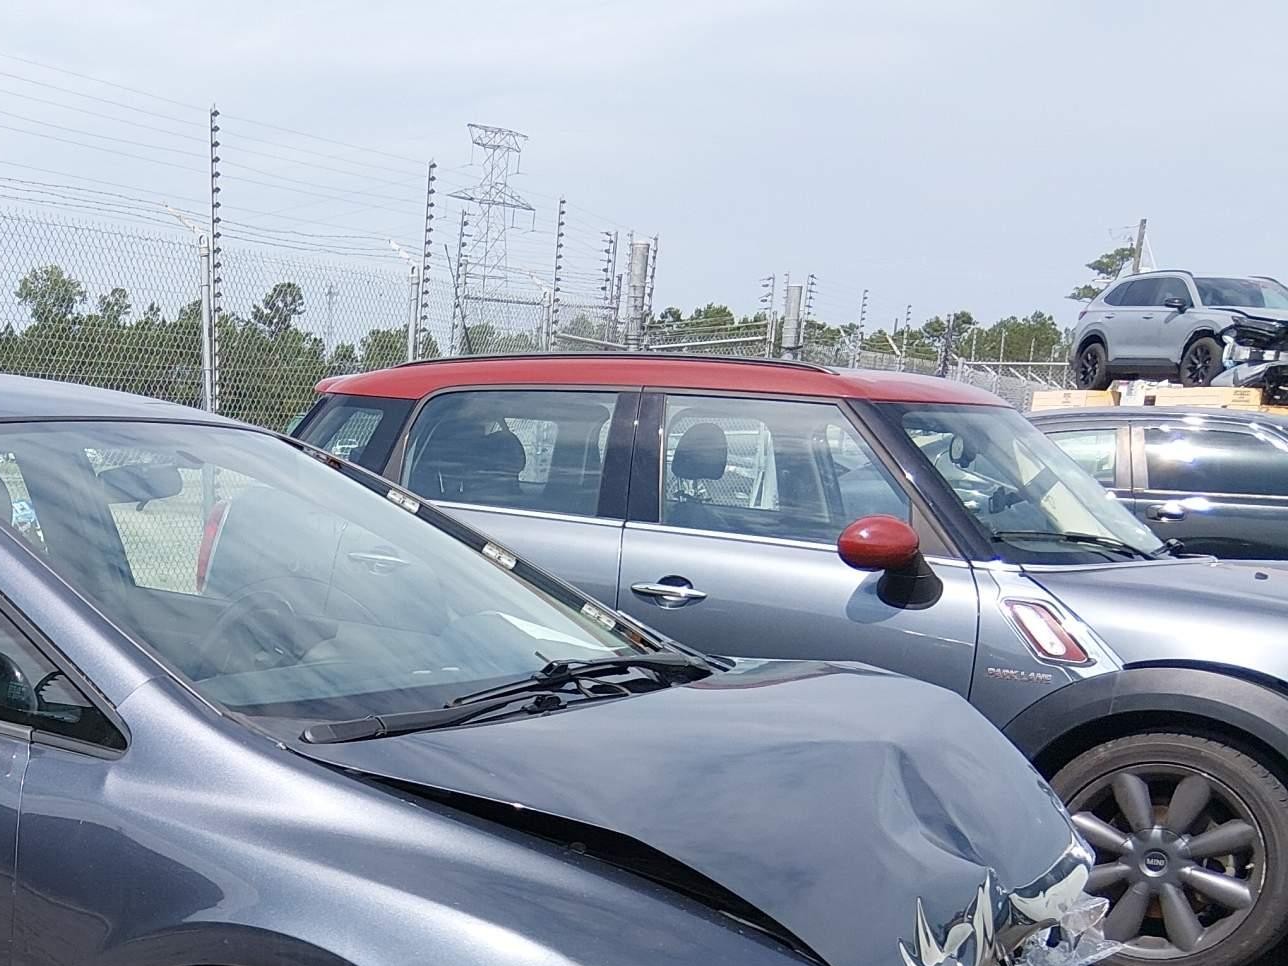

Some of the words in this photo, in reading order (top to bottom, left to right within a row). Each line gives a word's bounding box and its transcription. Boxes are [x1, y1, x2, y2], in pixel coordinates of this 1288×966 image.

[987, 667, 1019, 681] PARK
[1020, 671, 1053, 684] LANE
[1146, 857, 1165, 866] MINI
